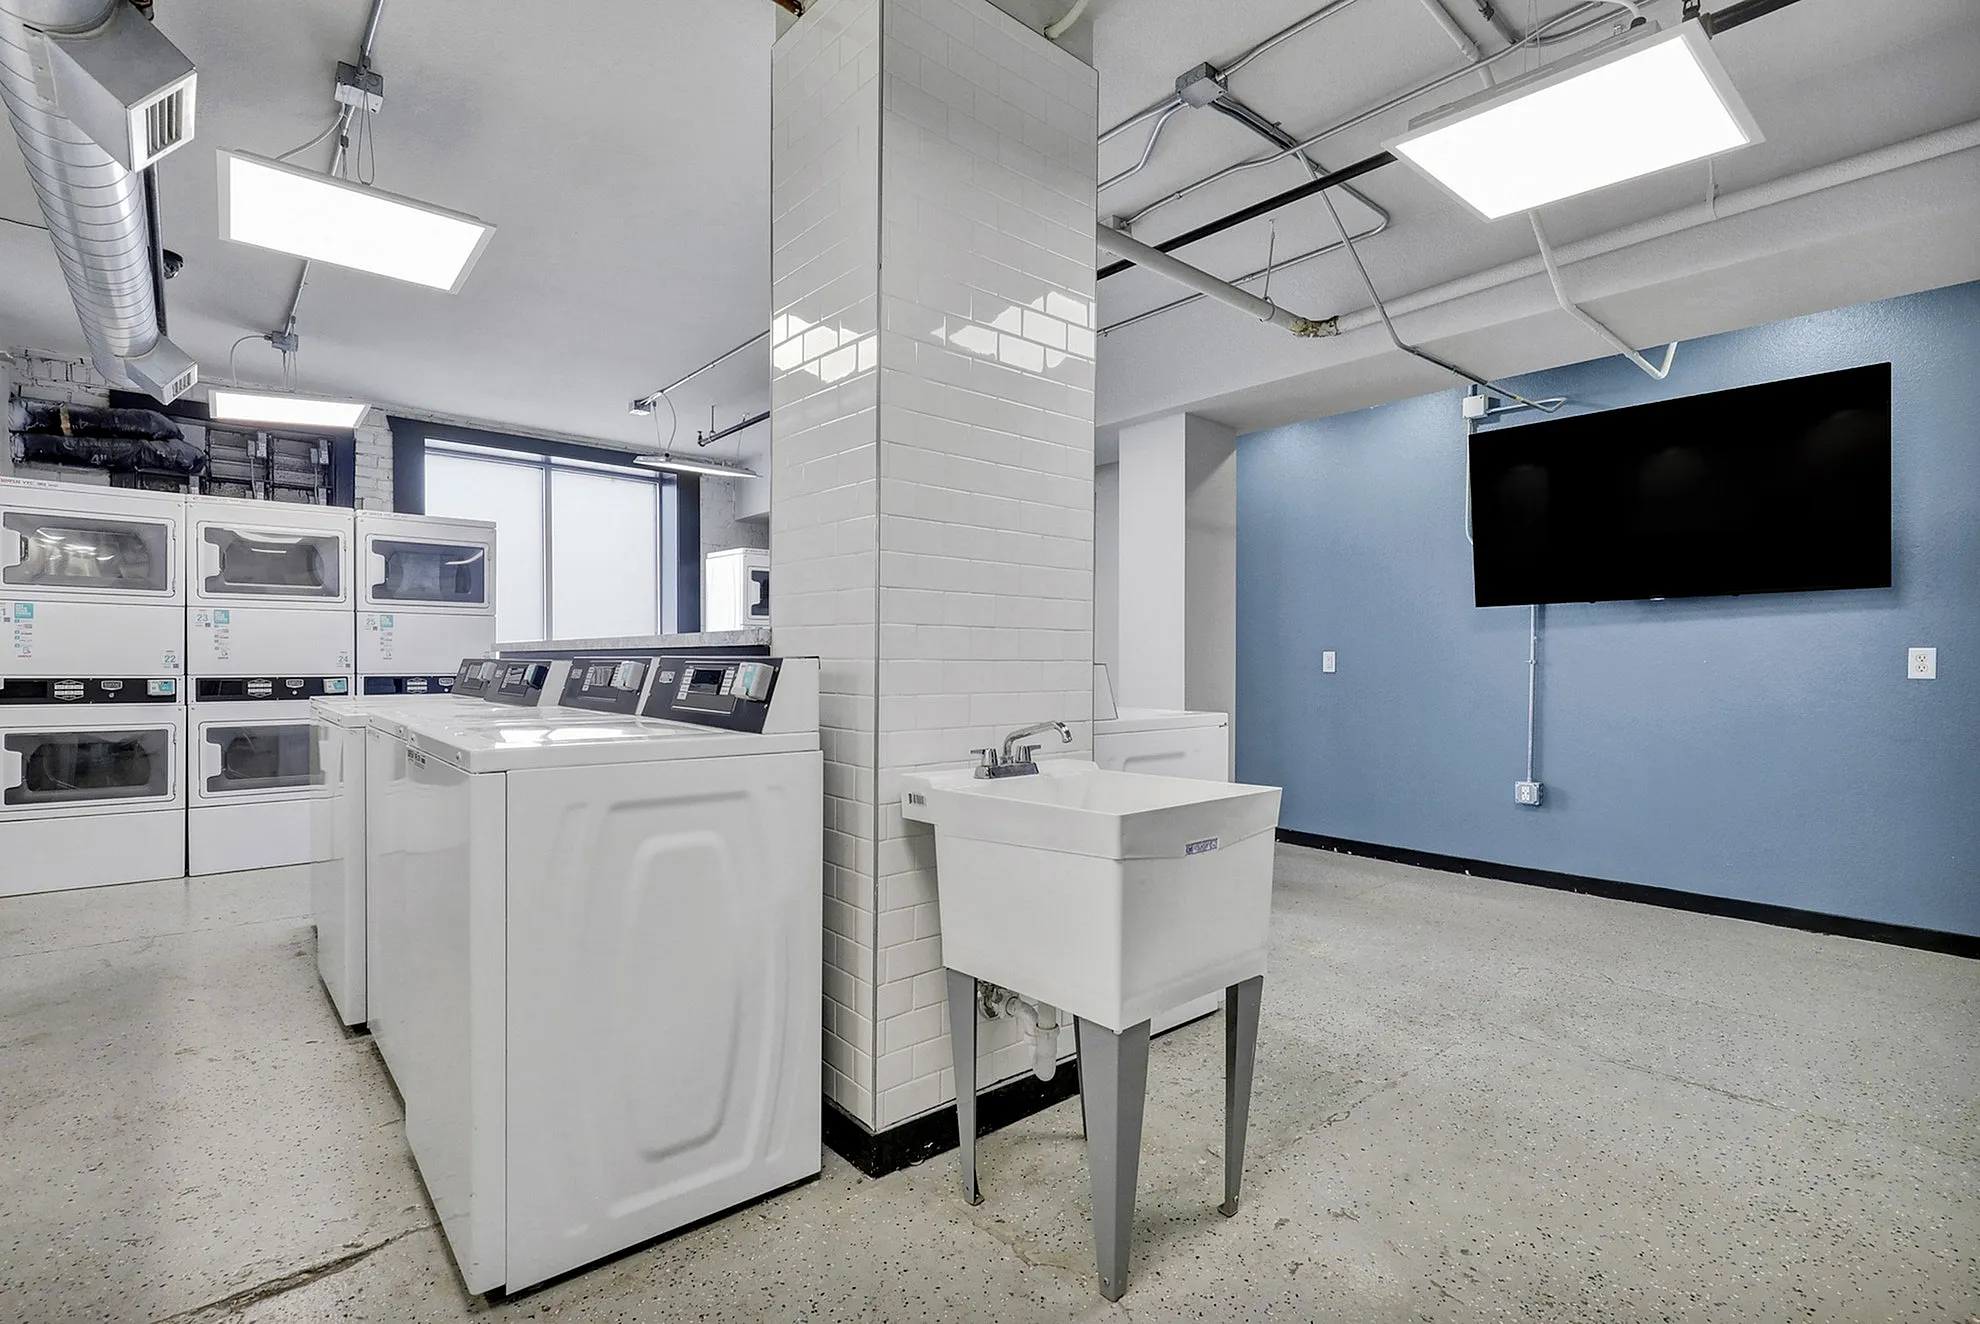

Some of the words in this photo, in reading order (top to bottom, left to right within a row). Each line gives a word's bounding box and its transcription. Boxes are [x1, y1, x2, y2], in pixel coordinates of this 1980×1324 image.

[90, 454, 107, 465] 4"
[196, 613, 208, 621] 23
[164, 655, 176, 663] 22
